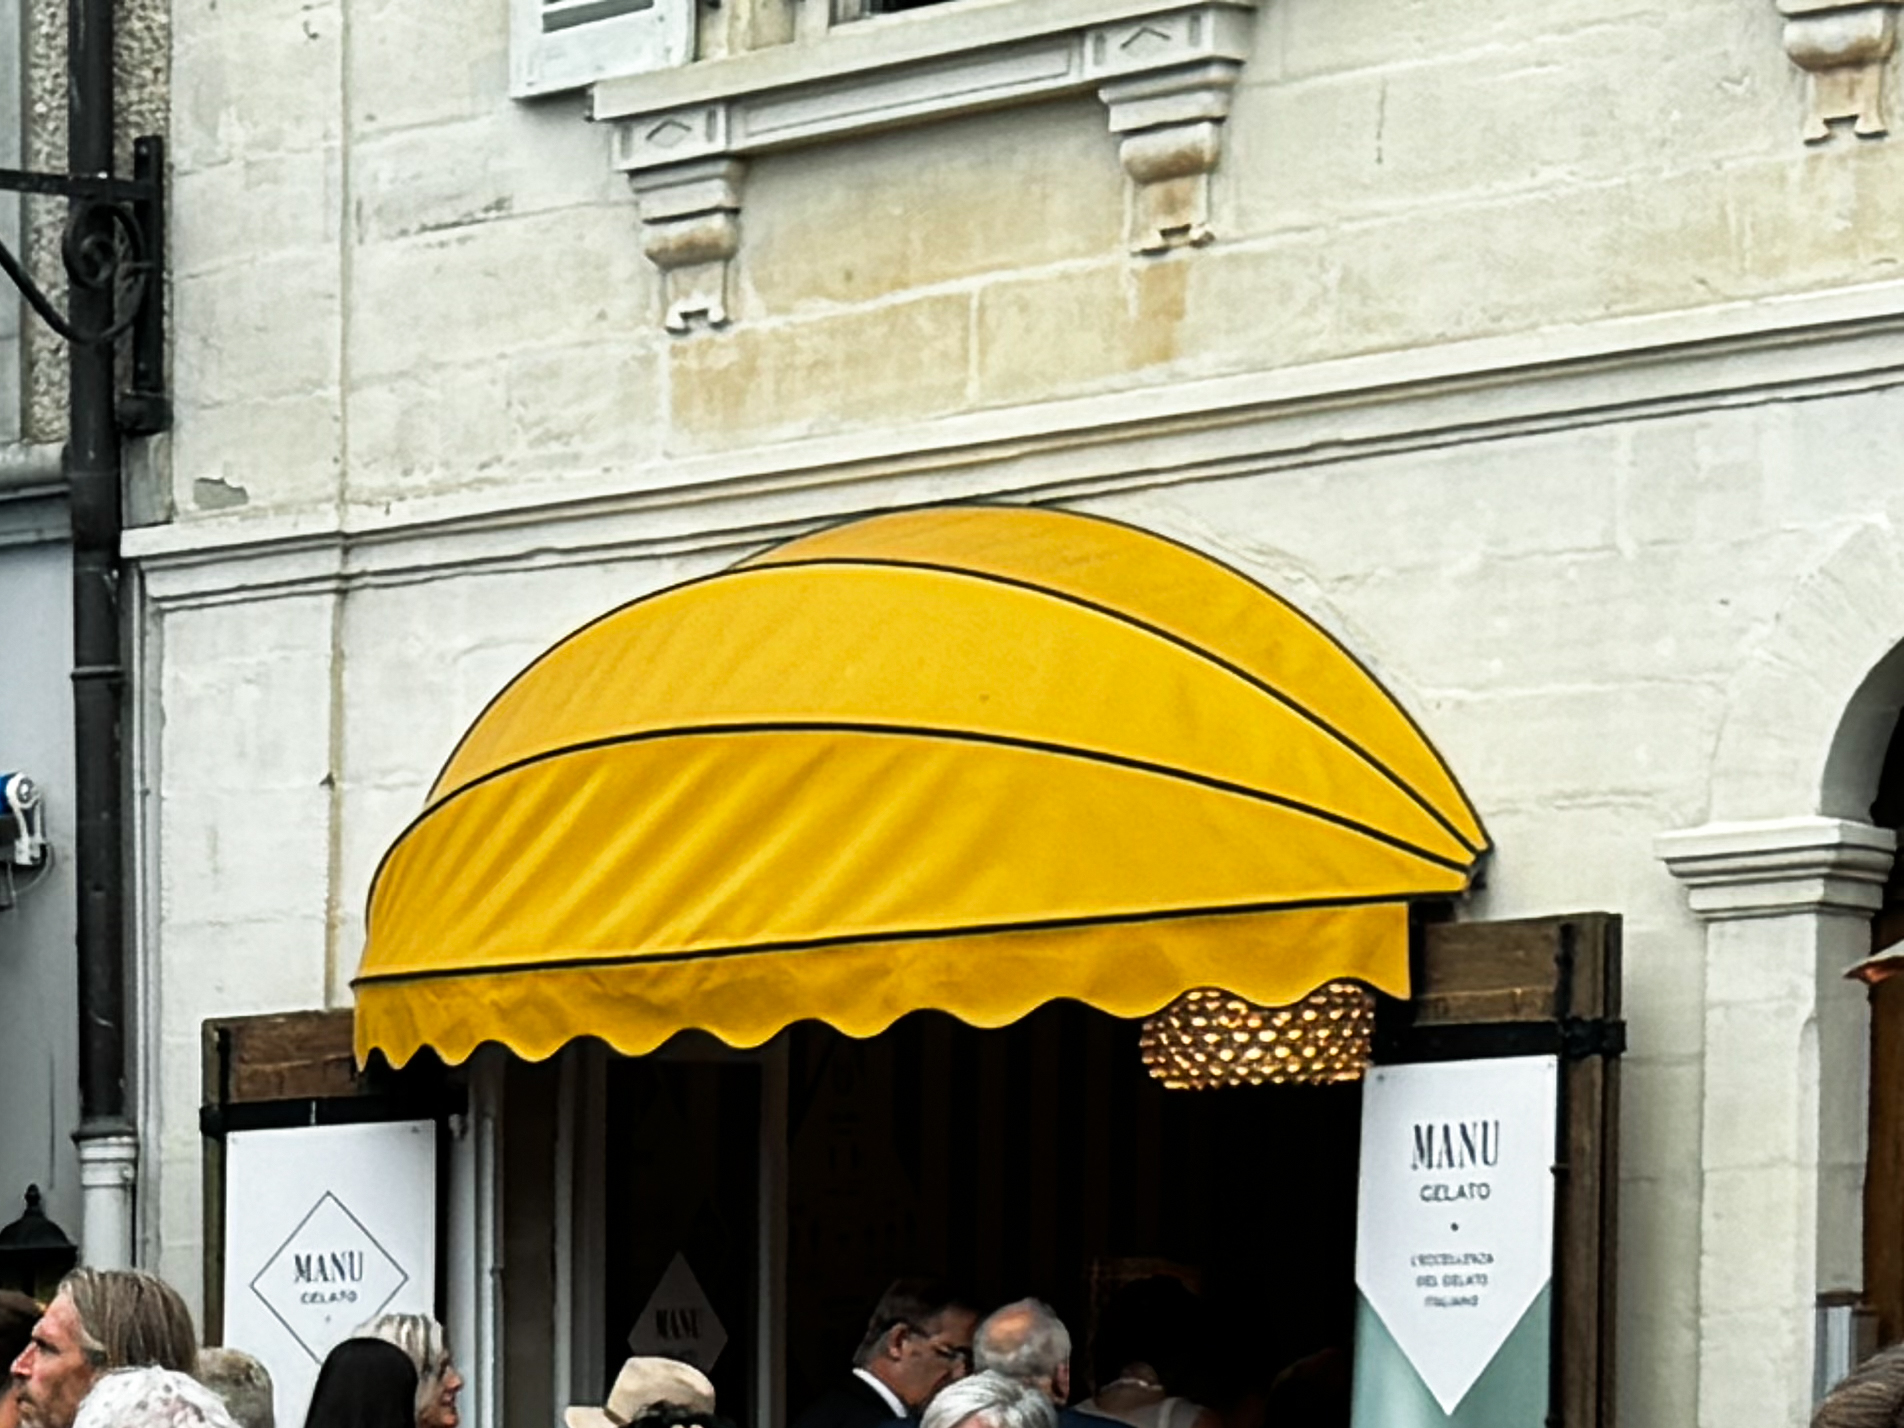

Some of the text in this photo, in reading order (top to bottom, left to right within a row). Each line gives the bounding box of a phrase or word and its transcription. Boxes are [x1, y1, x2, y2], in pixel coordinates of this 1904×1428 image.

[1410, 1119, 1500, 1171] MANU
[1419, 1182, 1491, 1202] GELATO
[293, 1248, 363, 1283] MANU
[300, 1289, 358, 1305] GELATO
